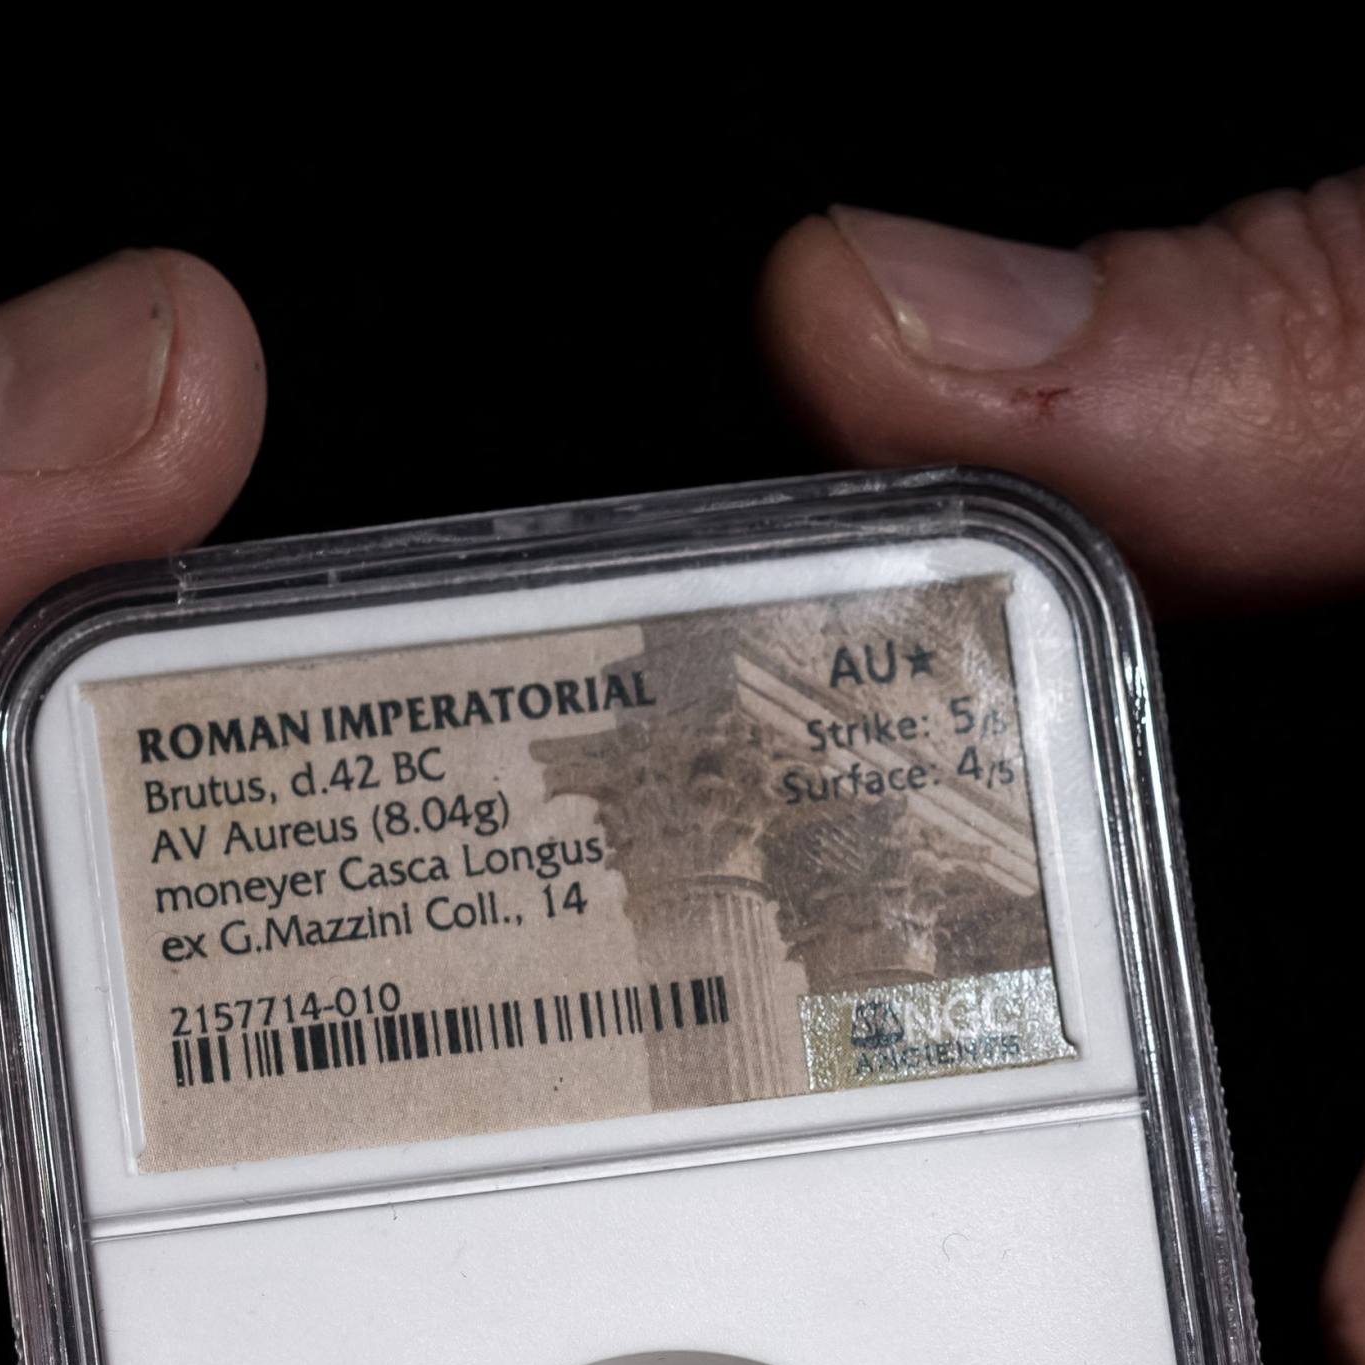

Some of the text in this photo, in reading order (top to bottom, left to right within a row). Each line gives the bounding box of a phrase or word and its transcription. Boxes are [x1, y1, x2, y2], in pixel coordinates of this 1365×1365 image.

[137, 671, 656, 764] ROMAN IMPERATORIAL
[807, 713, 930, 753] Strike:
[144, 746, 445, 814] Brutus, d.42 BC
[783, 746, 1015, 805] Surface: 4/5
[151, 790, 509, 864] AV Aureus (8.04g)
[155, 836, 603, 914] moneyer Casca Longus
[161, 881, 587, 963] ex G.Mazzini Coll., 14
[170, 982, 401, 1036] 2157714-010
